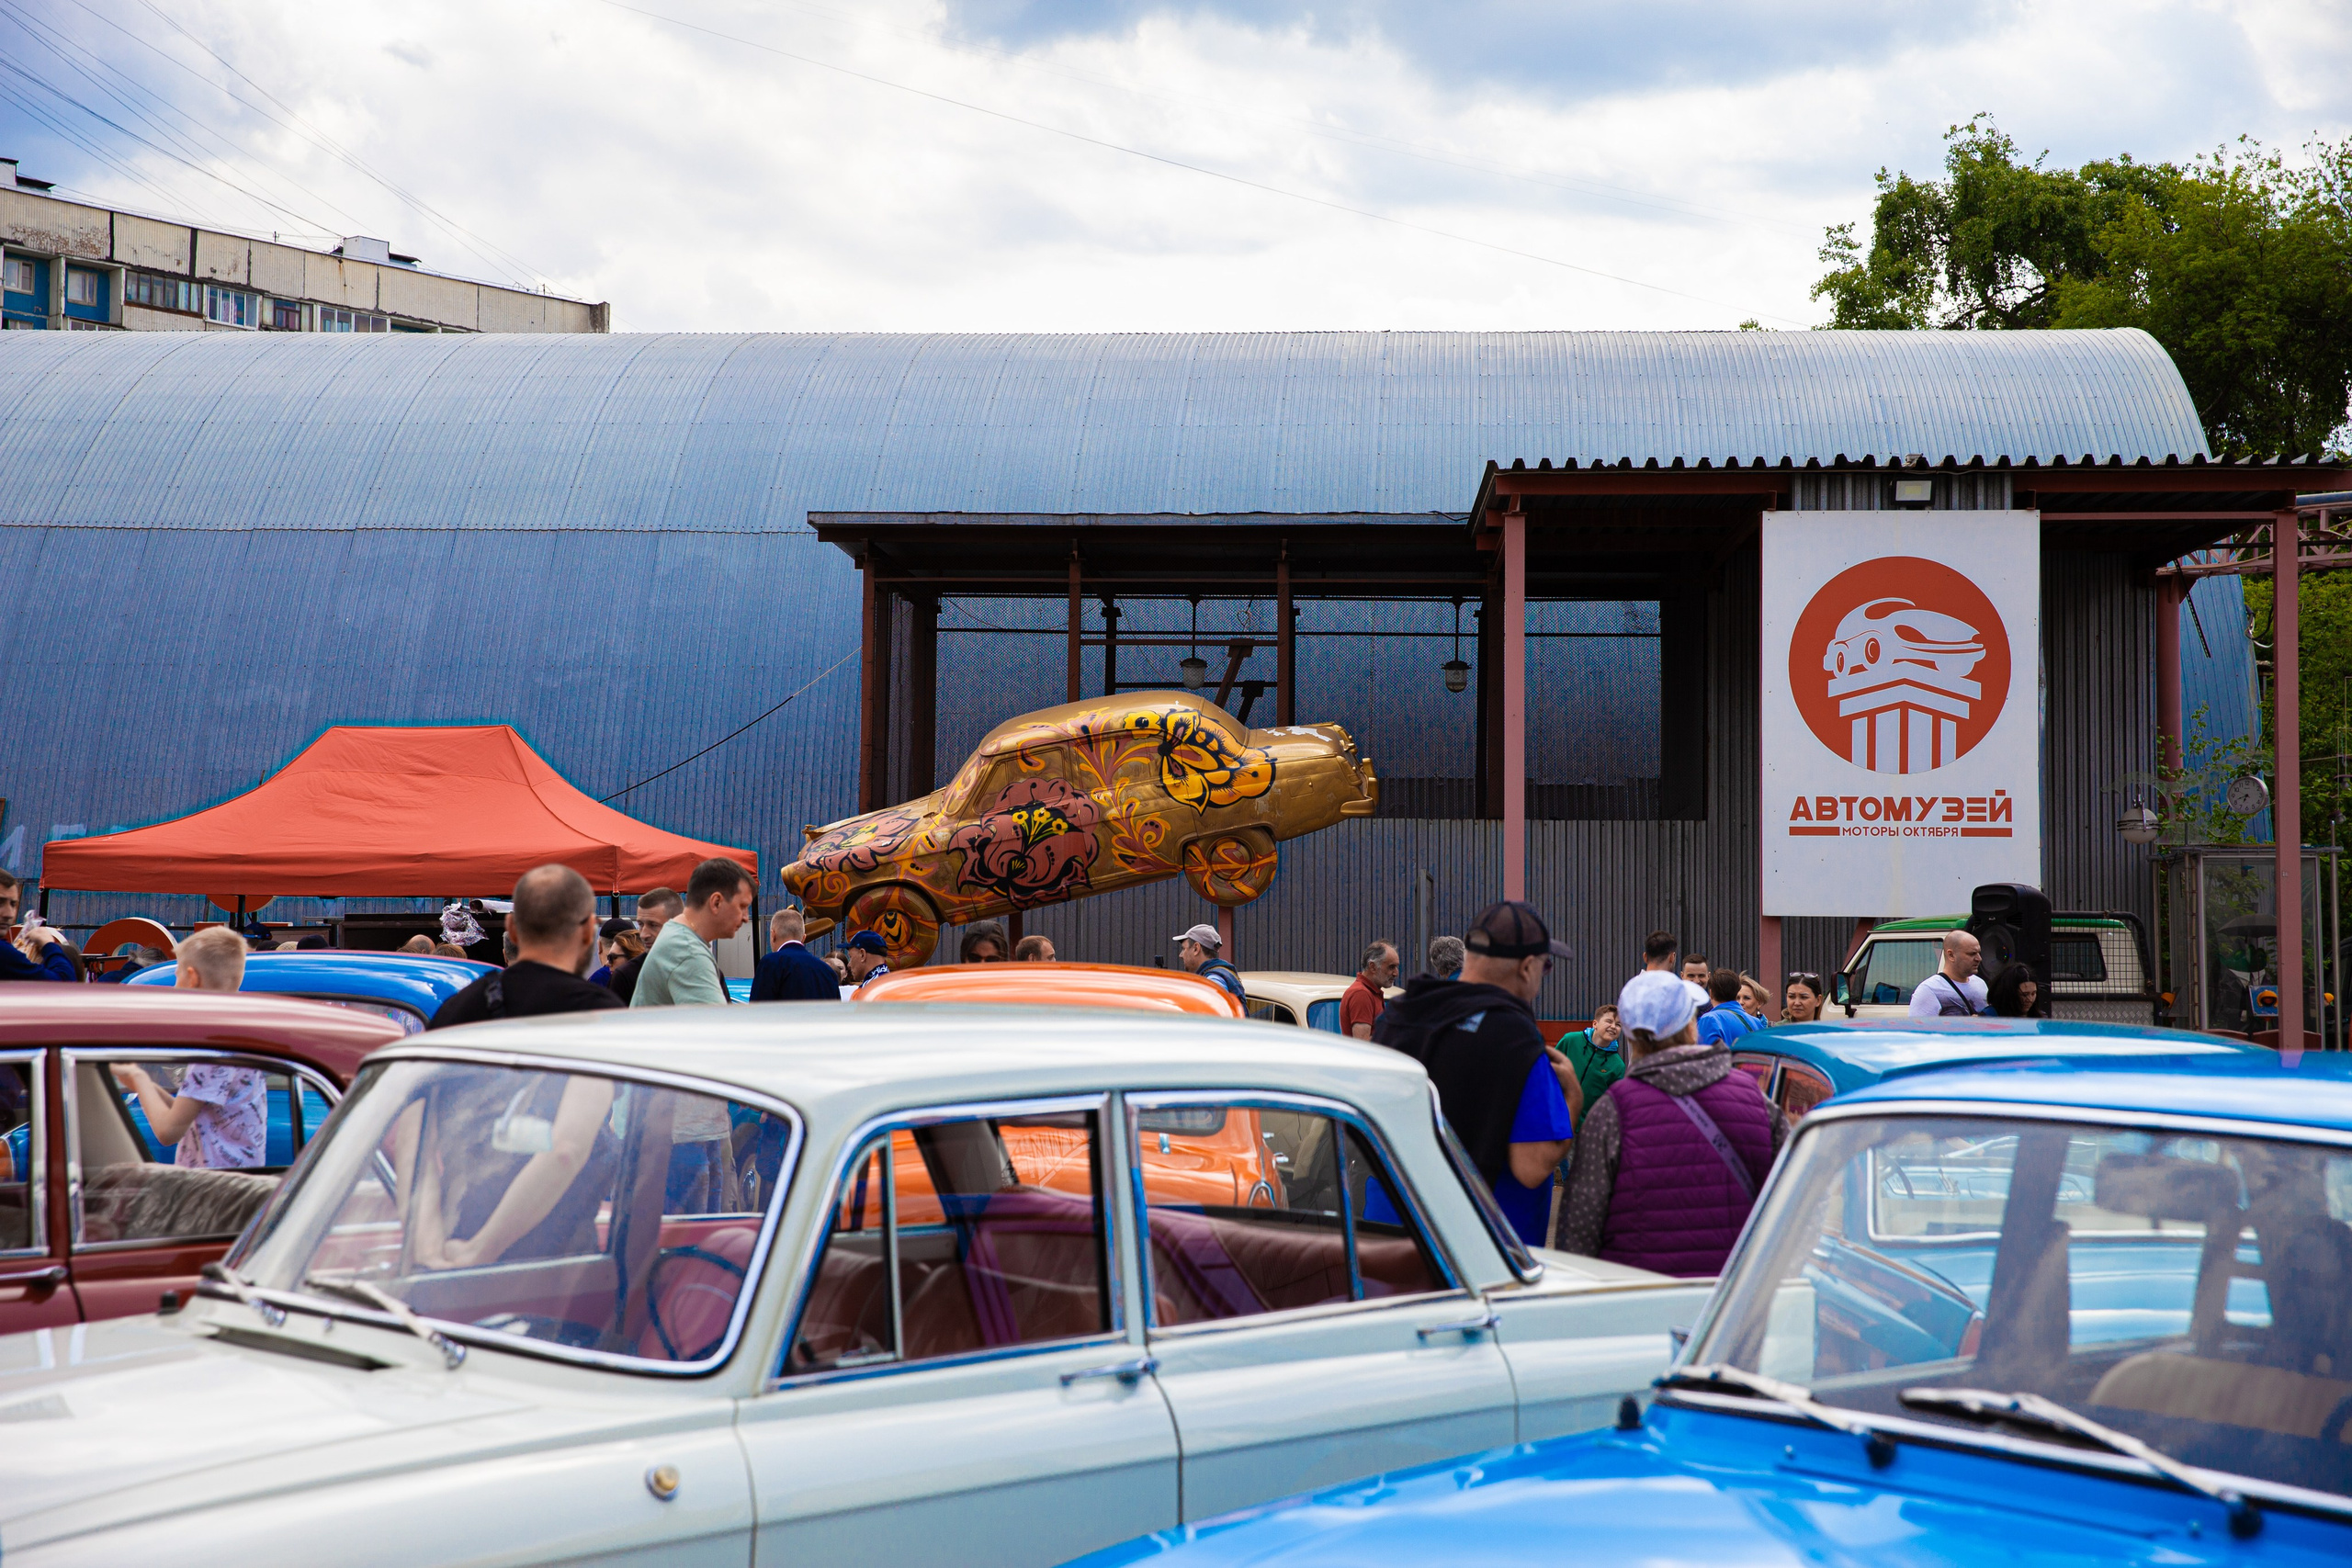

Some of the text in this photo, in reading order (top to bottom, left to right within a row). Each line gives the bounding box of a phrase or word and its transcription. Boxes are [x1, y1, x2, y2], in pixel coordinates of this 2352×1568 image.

[1789, 789, 2012, 822] АВТОМУЗЕЙ
[1842, 827, 1959, 837] МОТОРЫ ОКТЯБРЯ
